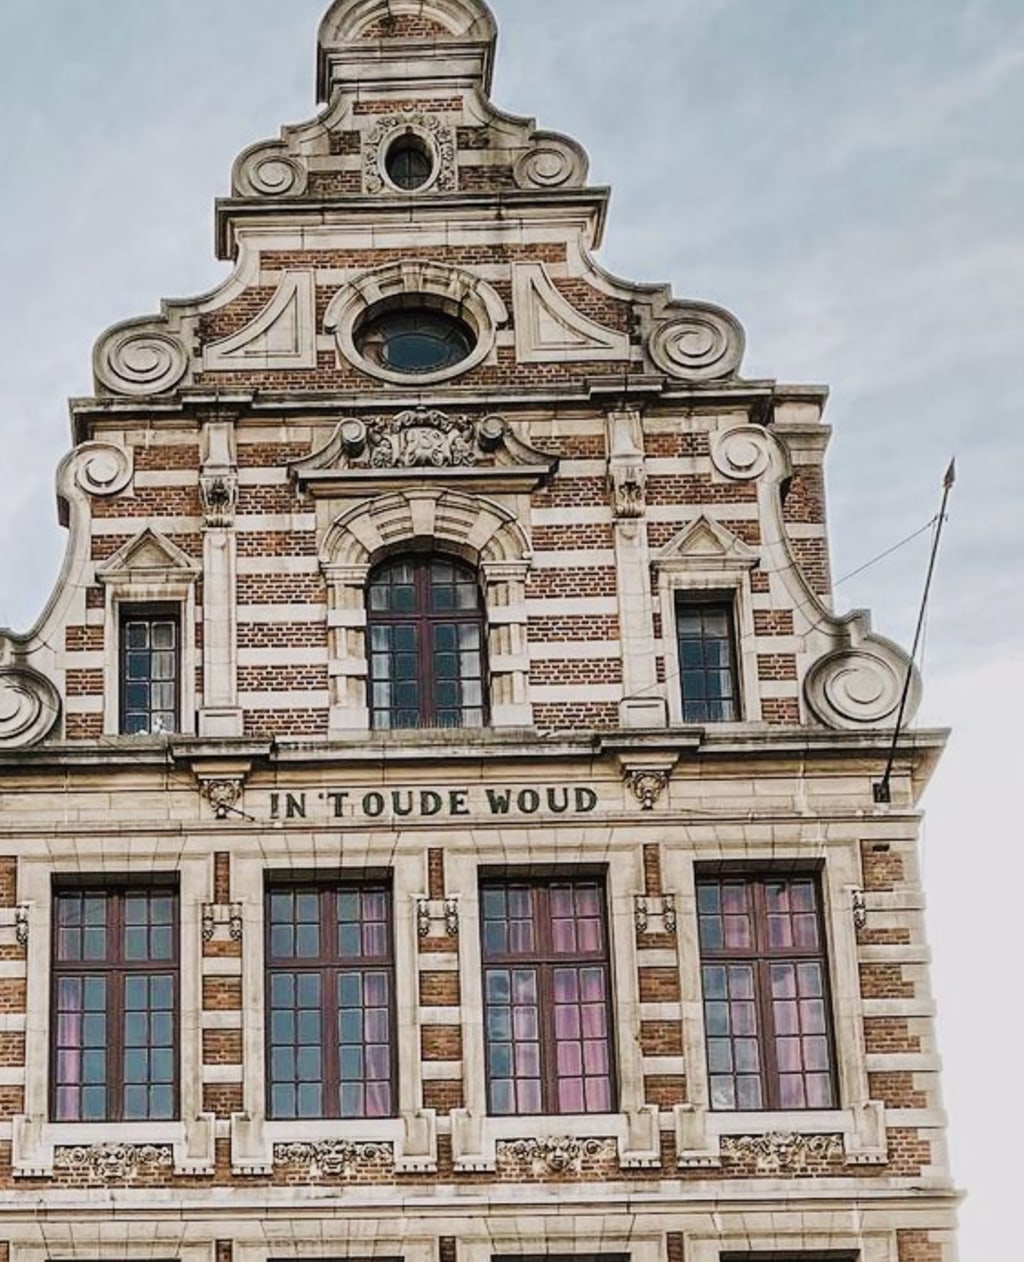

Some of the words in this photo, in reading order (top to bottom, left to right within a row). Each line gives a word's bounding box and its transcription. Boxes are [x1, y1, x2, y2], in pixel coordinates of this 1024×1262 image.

[269, 792, 306, 820] IN
[362, 789, 470, 817] OUDE
[484, 786, 599, 815] WOUD
